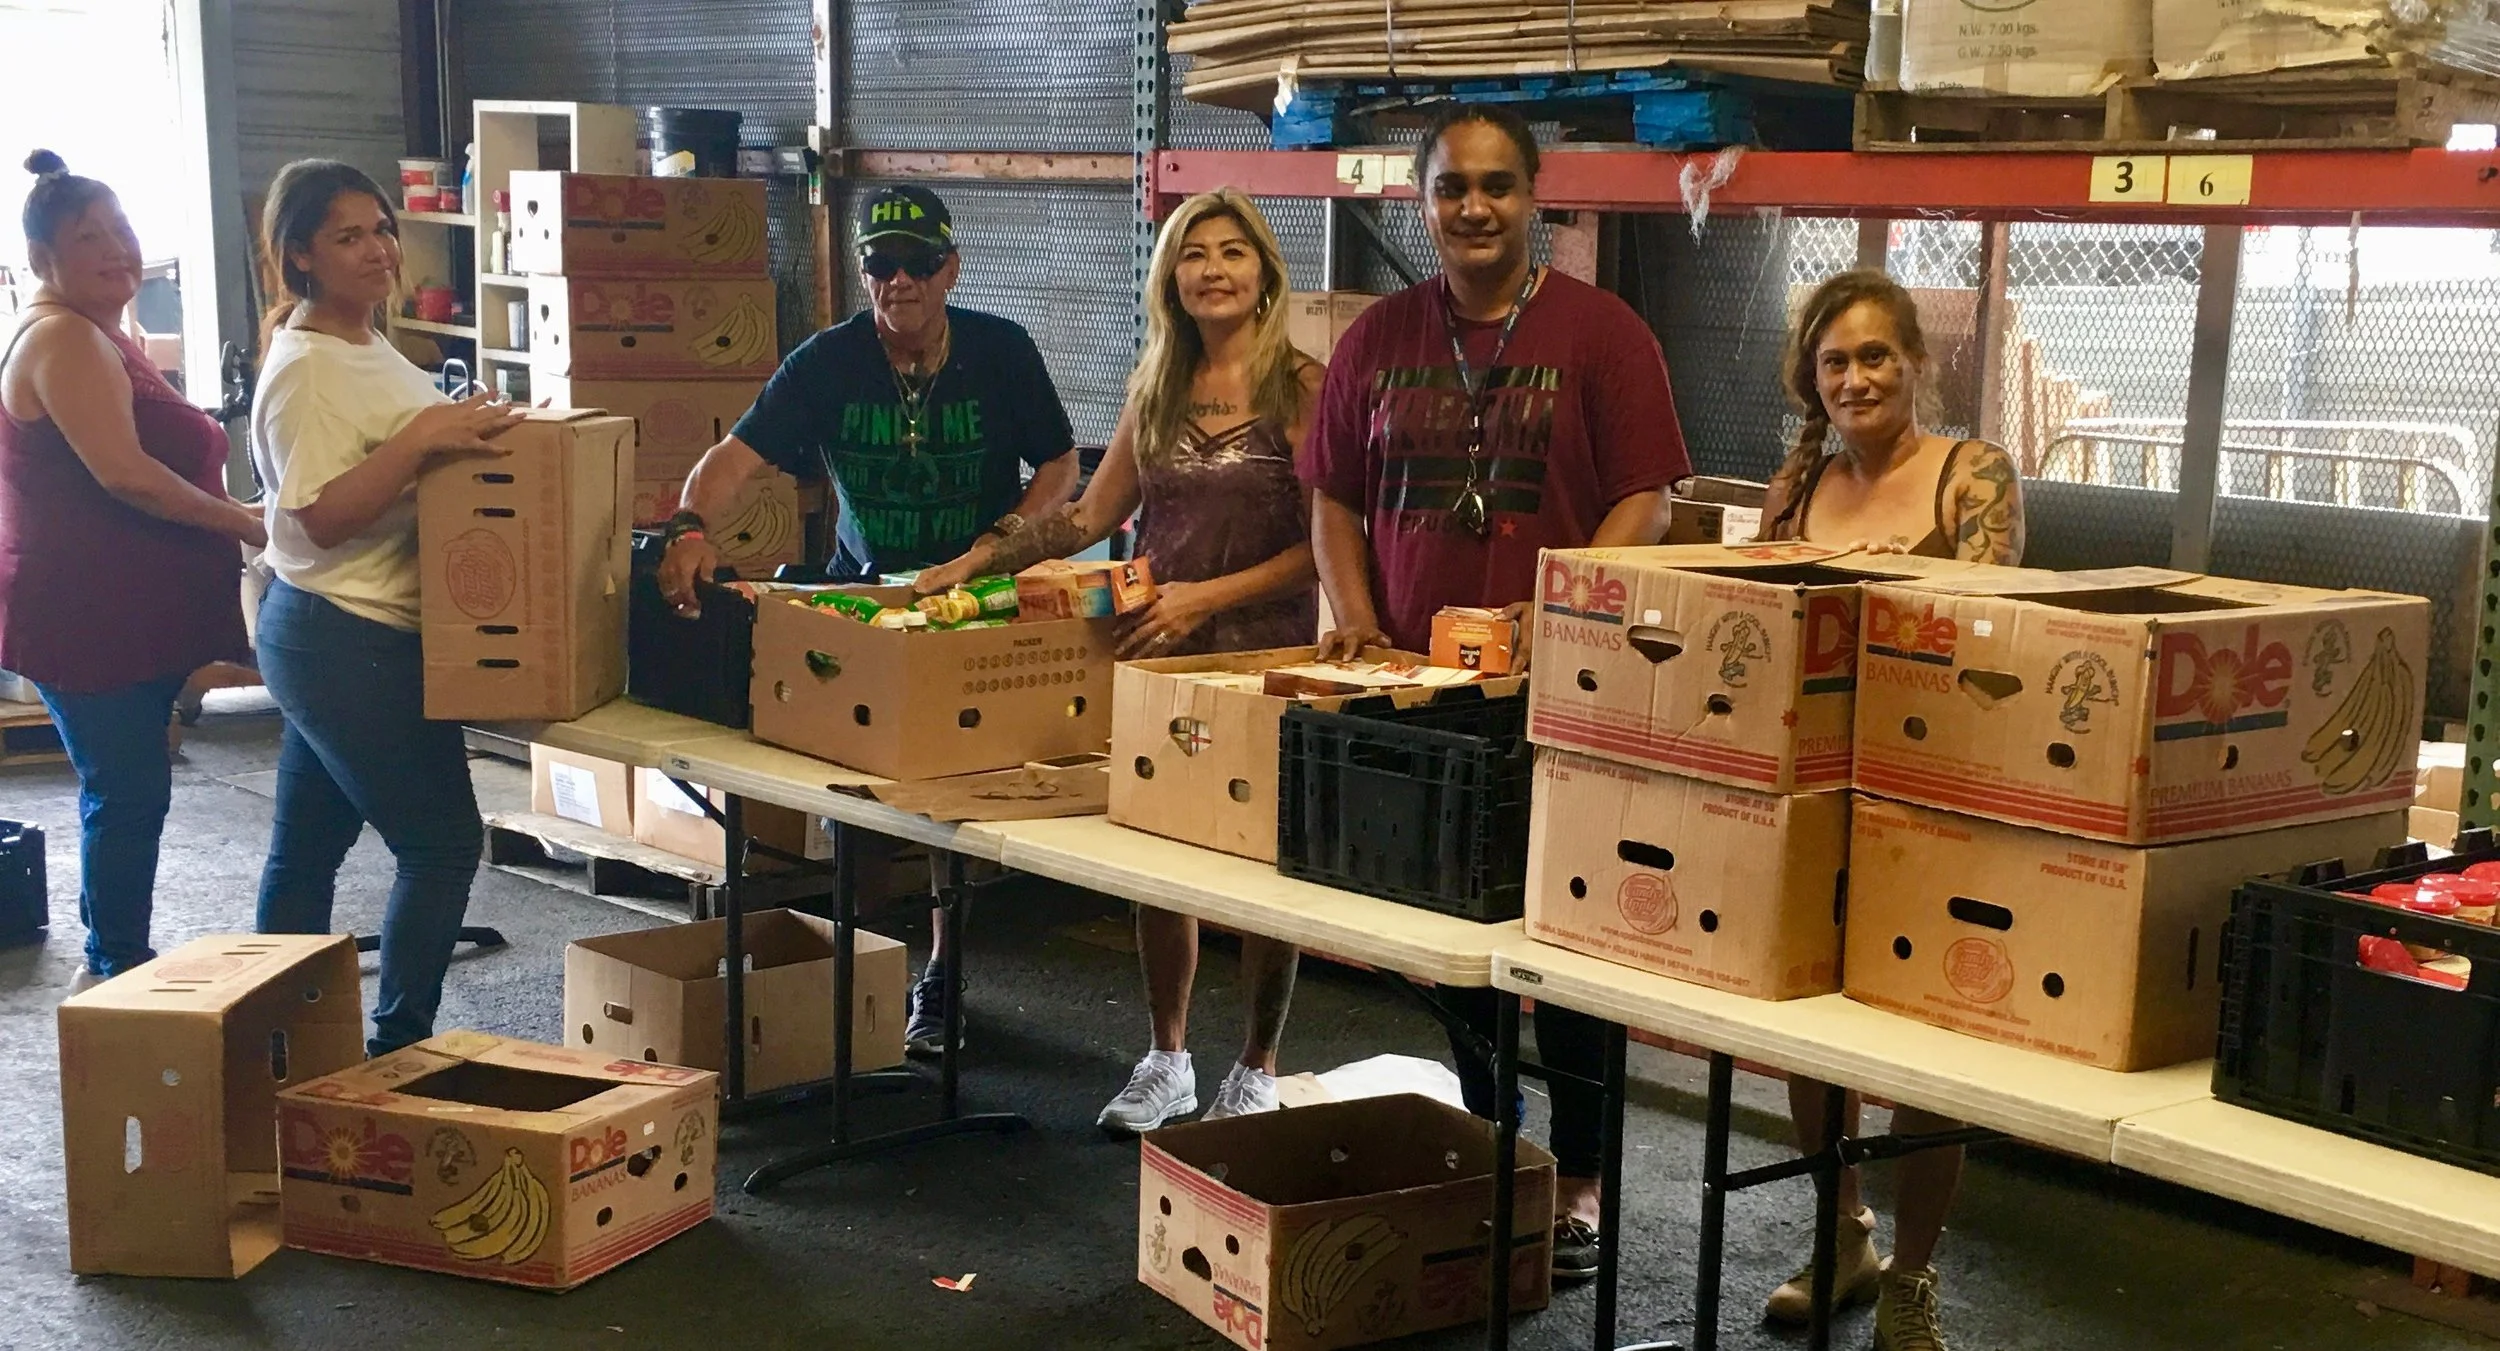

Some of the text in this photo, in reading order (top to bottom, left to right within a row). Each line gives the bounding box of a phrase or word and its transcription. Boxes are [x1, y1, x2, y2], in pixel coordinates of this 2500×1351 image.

[1351, 159, 1364, 184] 4
[2115, 161, 2134, 193] 3
[2199, 172, 2214, 197] 6
[871, 200, 901, 224] Hi
[942, 400, 984, 445] ME
[1543, 559, 1628, 613] Dole
[1542, 620, 1623, 652] BANANAS
[1866, 596, 1958, 654] Dole
[1866, 660, 1951, 694] BANANAS
[2155, 624, 2293, 724] Dole
[2151, 769, 2293, 807] PREMIUM BANANAS
[2040, 862, 2083, 881] PRODUCT
[2085, 871, 2097, 883] OF
[284, 1107, 415, 1184] Dole
[569, 1125, 627, 1173] Dole
[571, 1168, 627, 1202] BANANAS
[1213, 1298, 1262, 1351] Dole
